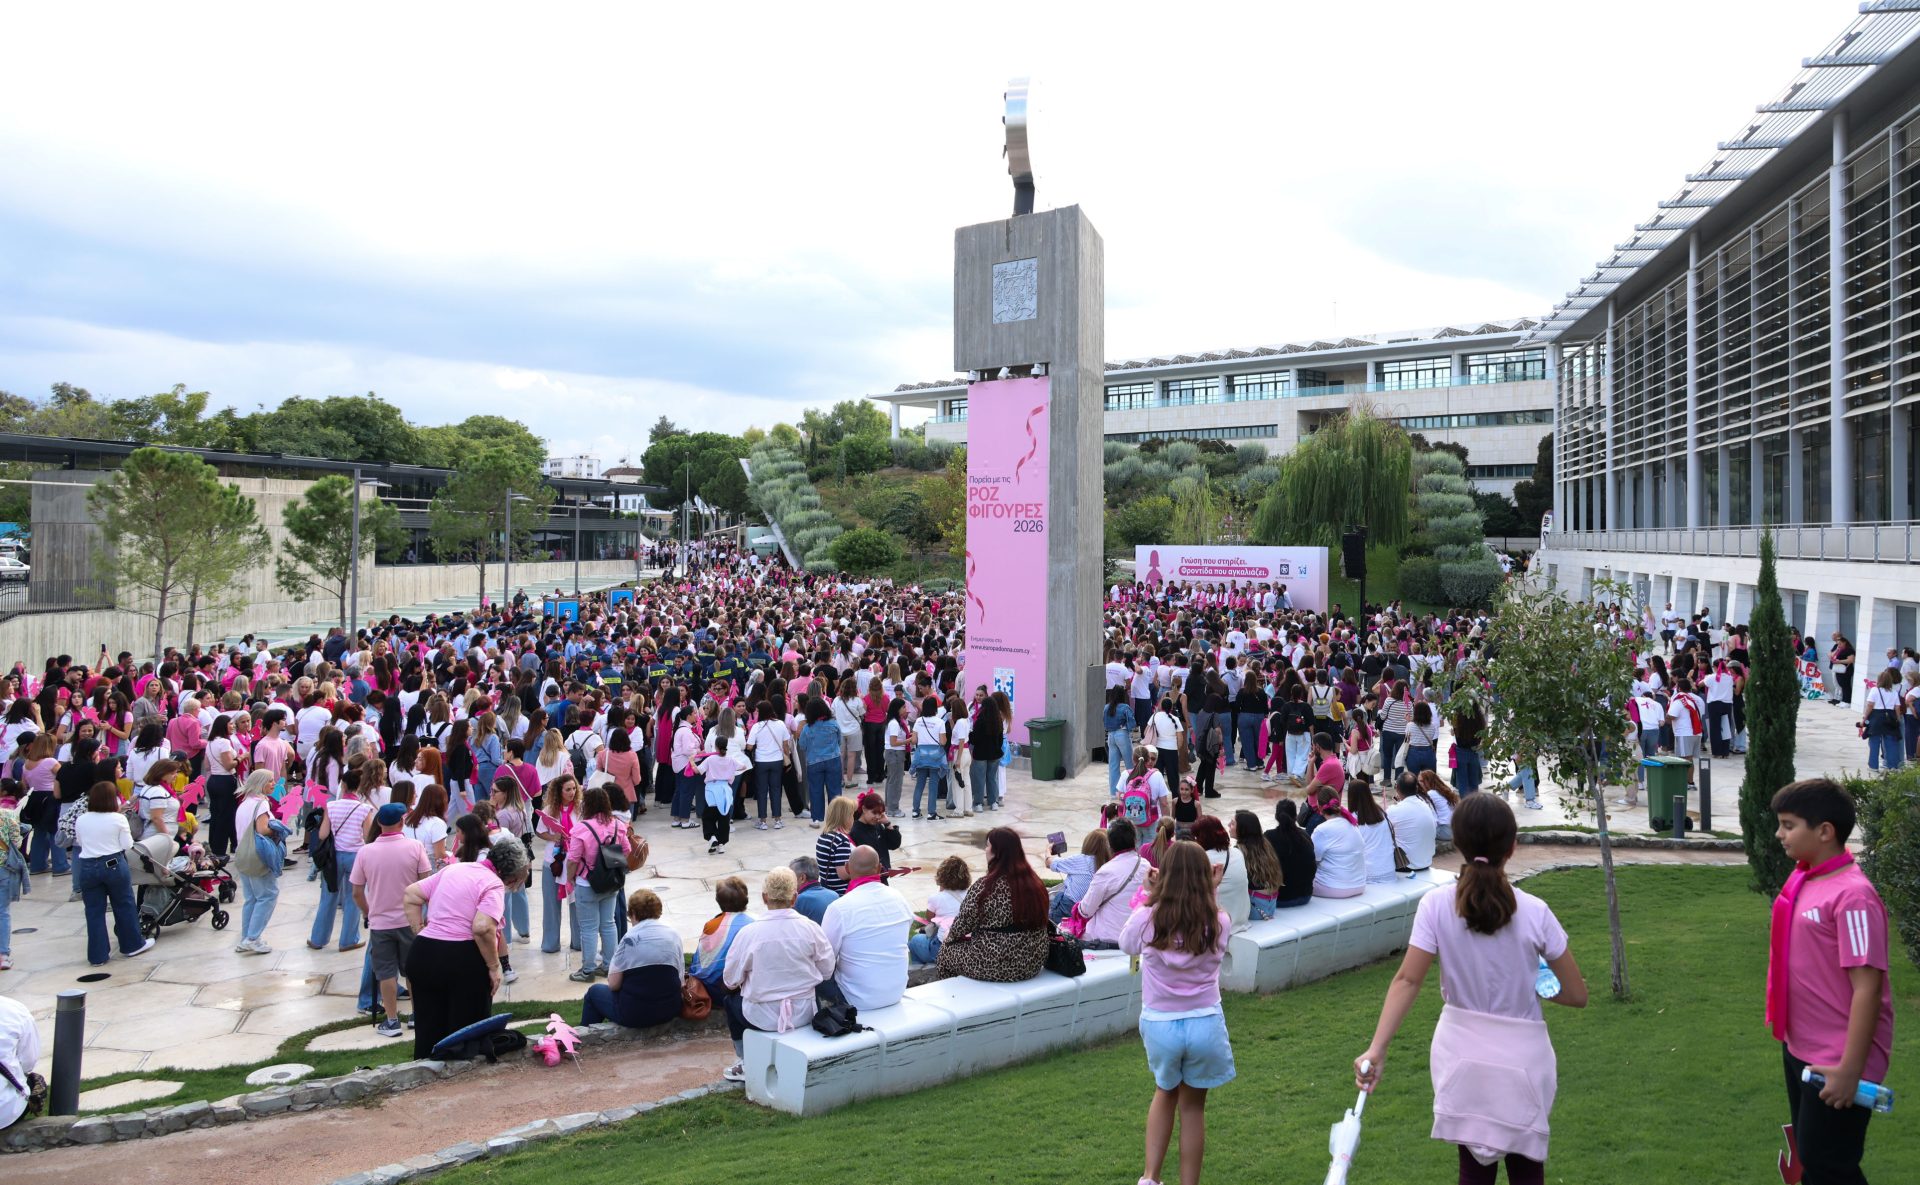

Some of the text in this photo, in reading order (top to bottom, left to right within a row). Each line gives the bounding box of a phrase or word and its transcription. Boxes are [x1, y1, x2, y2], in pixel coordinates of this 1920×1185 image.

[969, 475, 1011, 485] Πορεία με τις
[969, 486, 1000, 501] ΡΟΖ
[969, 503, 1043, 518] ΦΙΓΟΥΡΕΣ
[1013, 519, 1044, 533] 2026
[1180, 556, 1202, 565] Γνώση
[1217, 557, 1248, 566] στηρίζει.
[1181, 566, 1213, 576] Φροντίδα
[1228, 567, 1267, 577] αγκαλιάζει.
